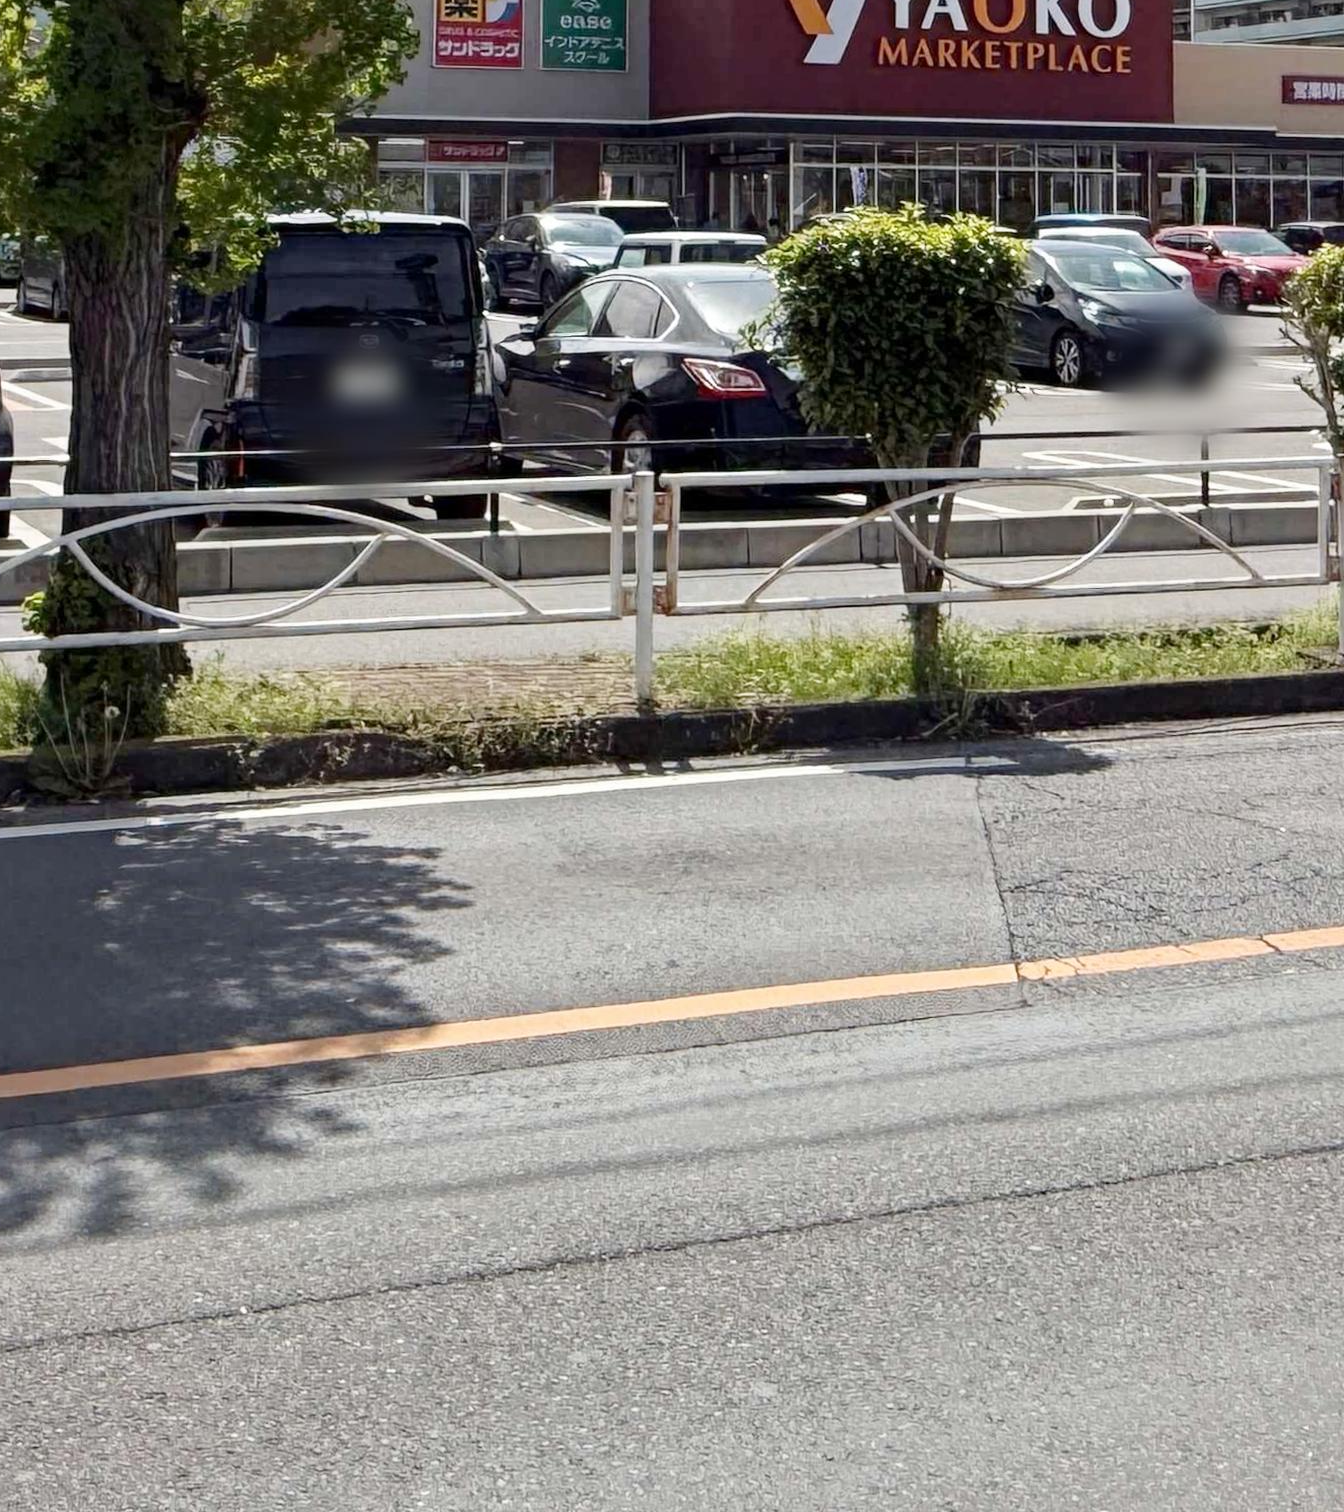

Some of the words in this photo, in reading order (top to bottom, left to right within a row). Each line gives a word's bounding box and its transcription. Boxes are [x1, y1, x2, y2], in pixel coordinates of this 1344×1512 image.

[438, 40, 519, 58] サンドラッグ
[878, 37, 1132, 73] MARKETPLACE
